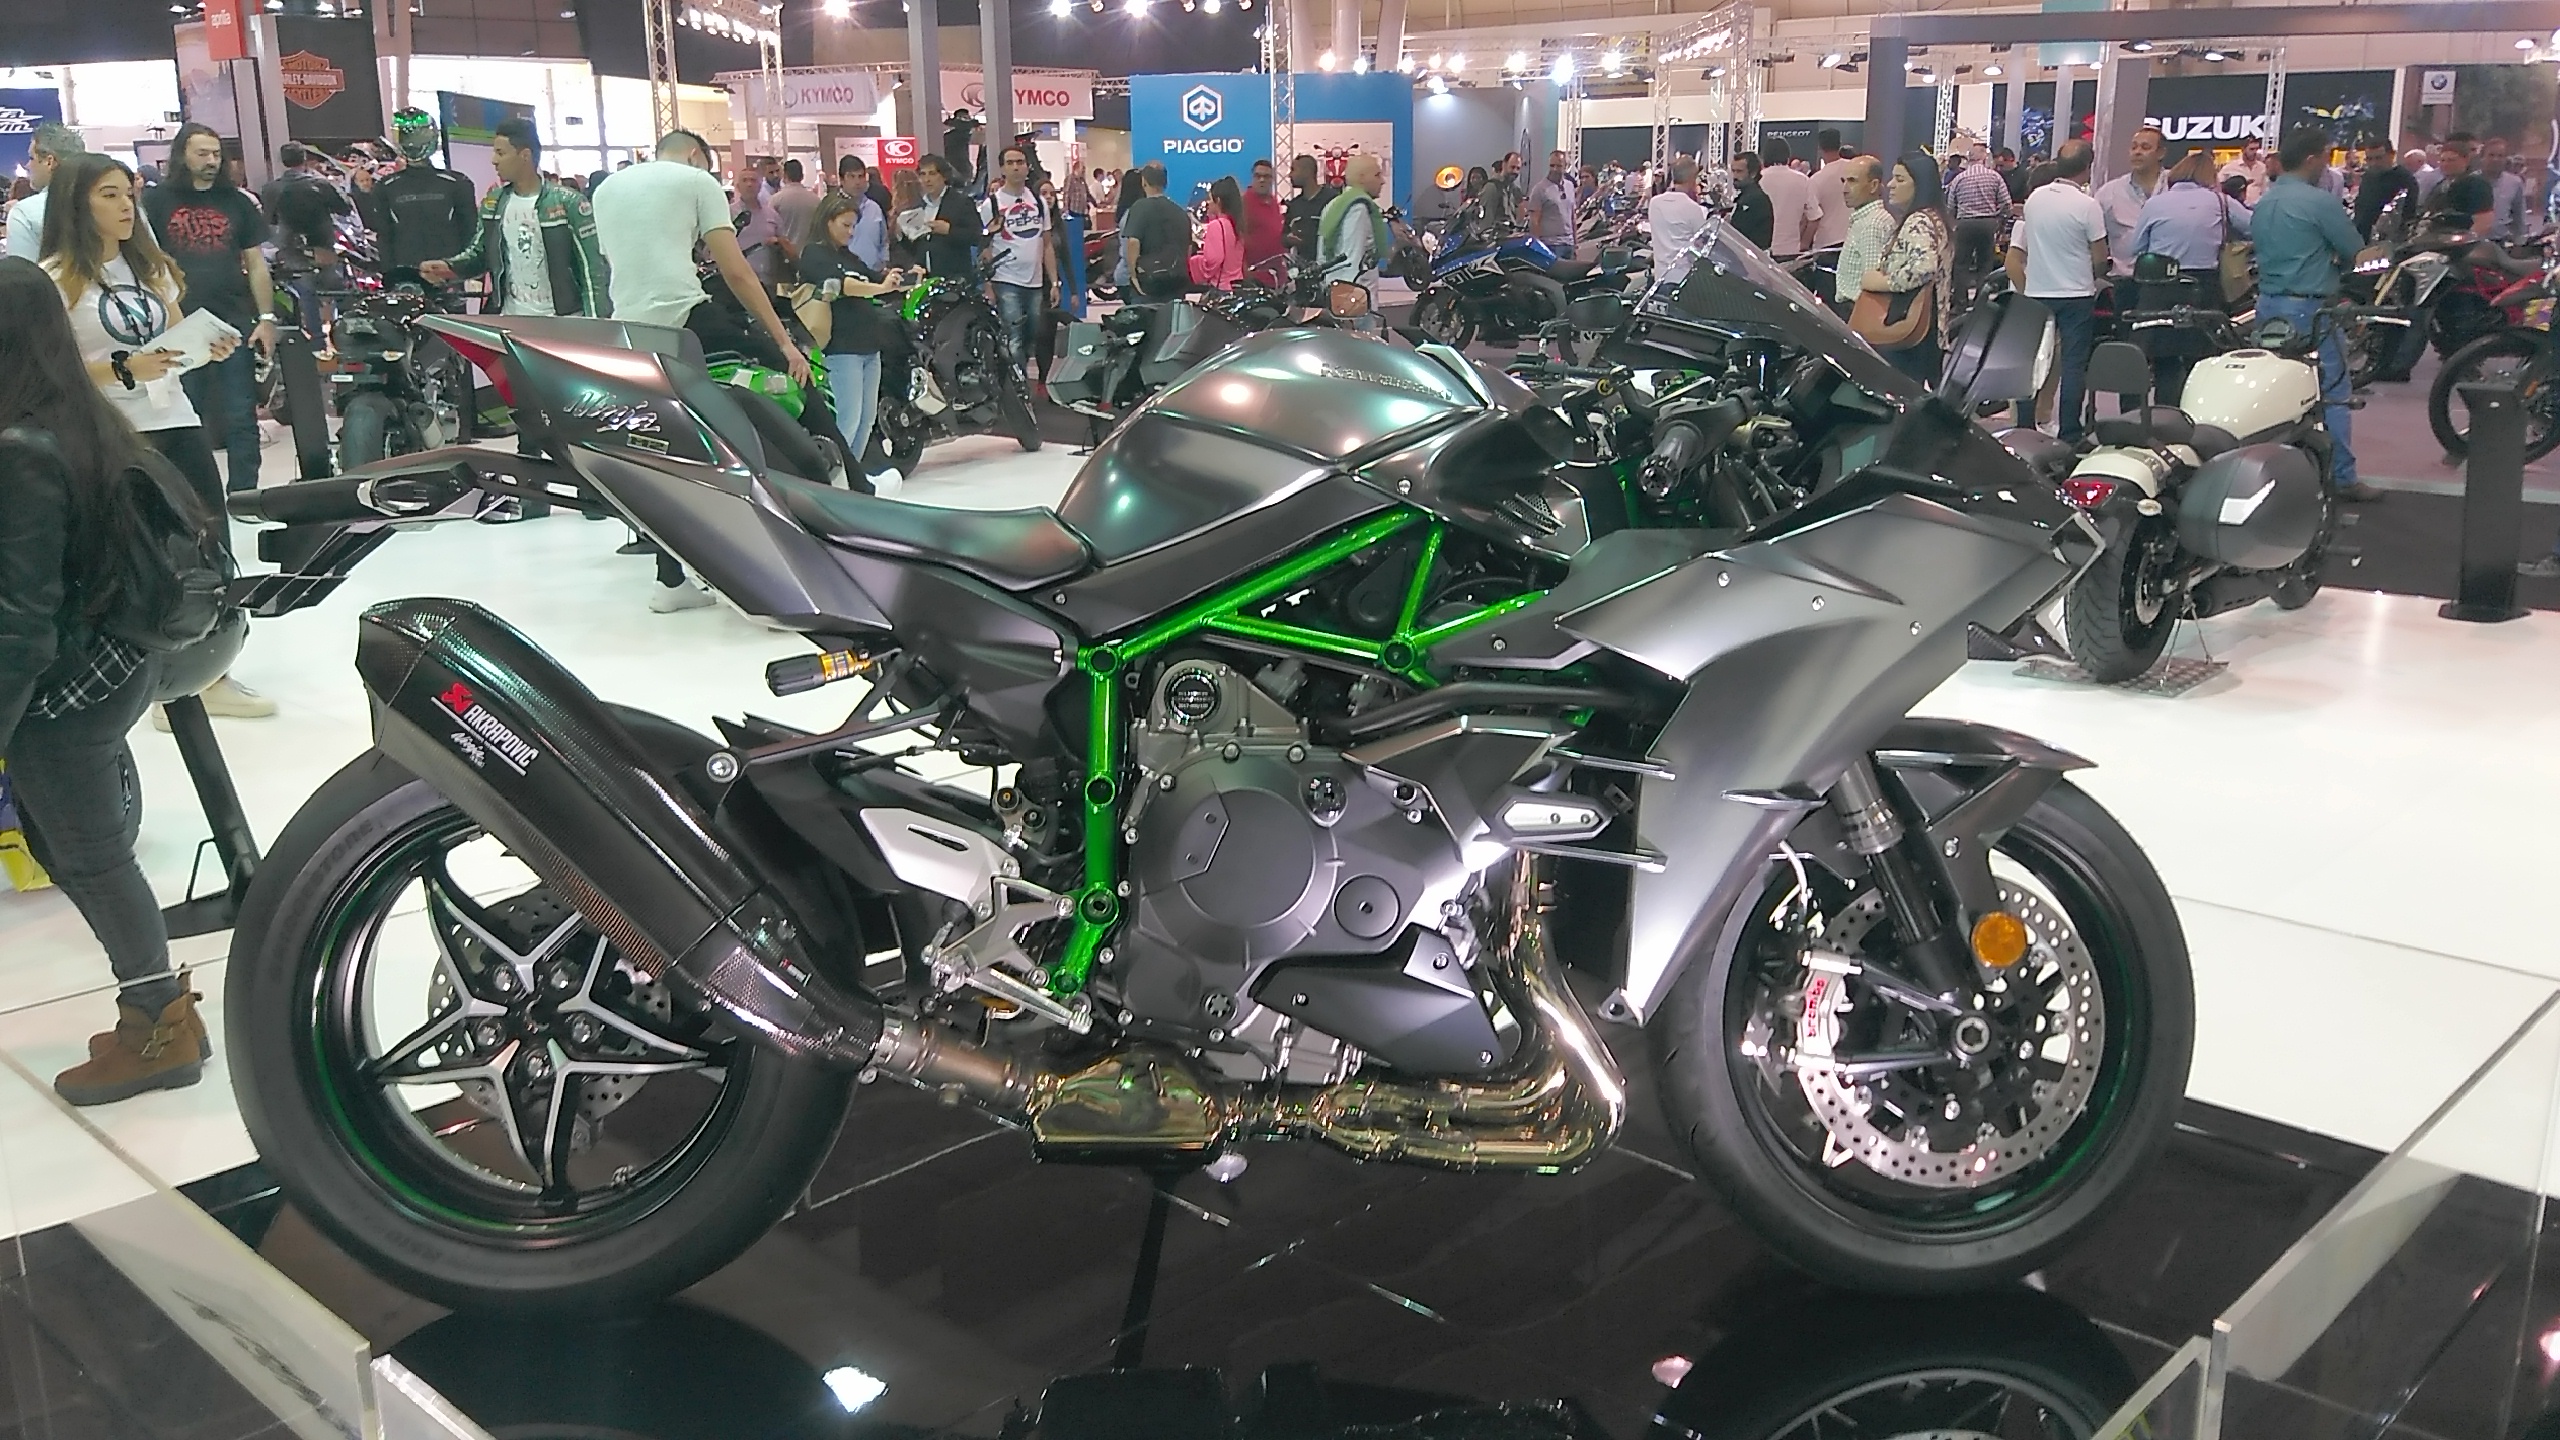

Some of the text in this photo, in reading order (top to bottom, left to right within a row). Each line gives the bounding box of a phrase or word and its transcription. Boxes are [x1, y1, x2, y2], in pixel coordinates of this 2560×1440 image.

[800, 86, 854, 105] KYMCO
[1014, 88, 1070, 107] YMCO
[1766, 130, 1811, 139] PEUGEOT
[1163, 138, 1243, 154] PIAGGIO
[1007, 215, 1043, 227] PEPS
[1320, 362, 1455, 400] Kawasaki
[563, 388, 661, 434] Ninja
[1806, 980, 1825, 1038] brembo
